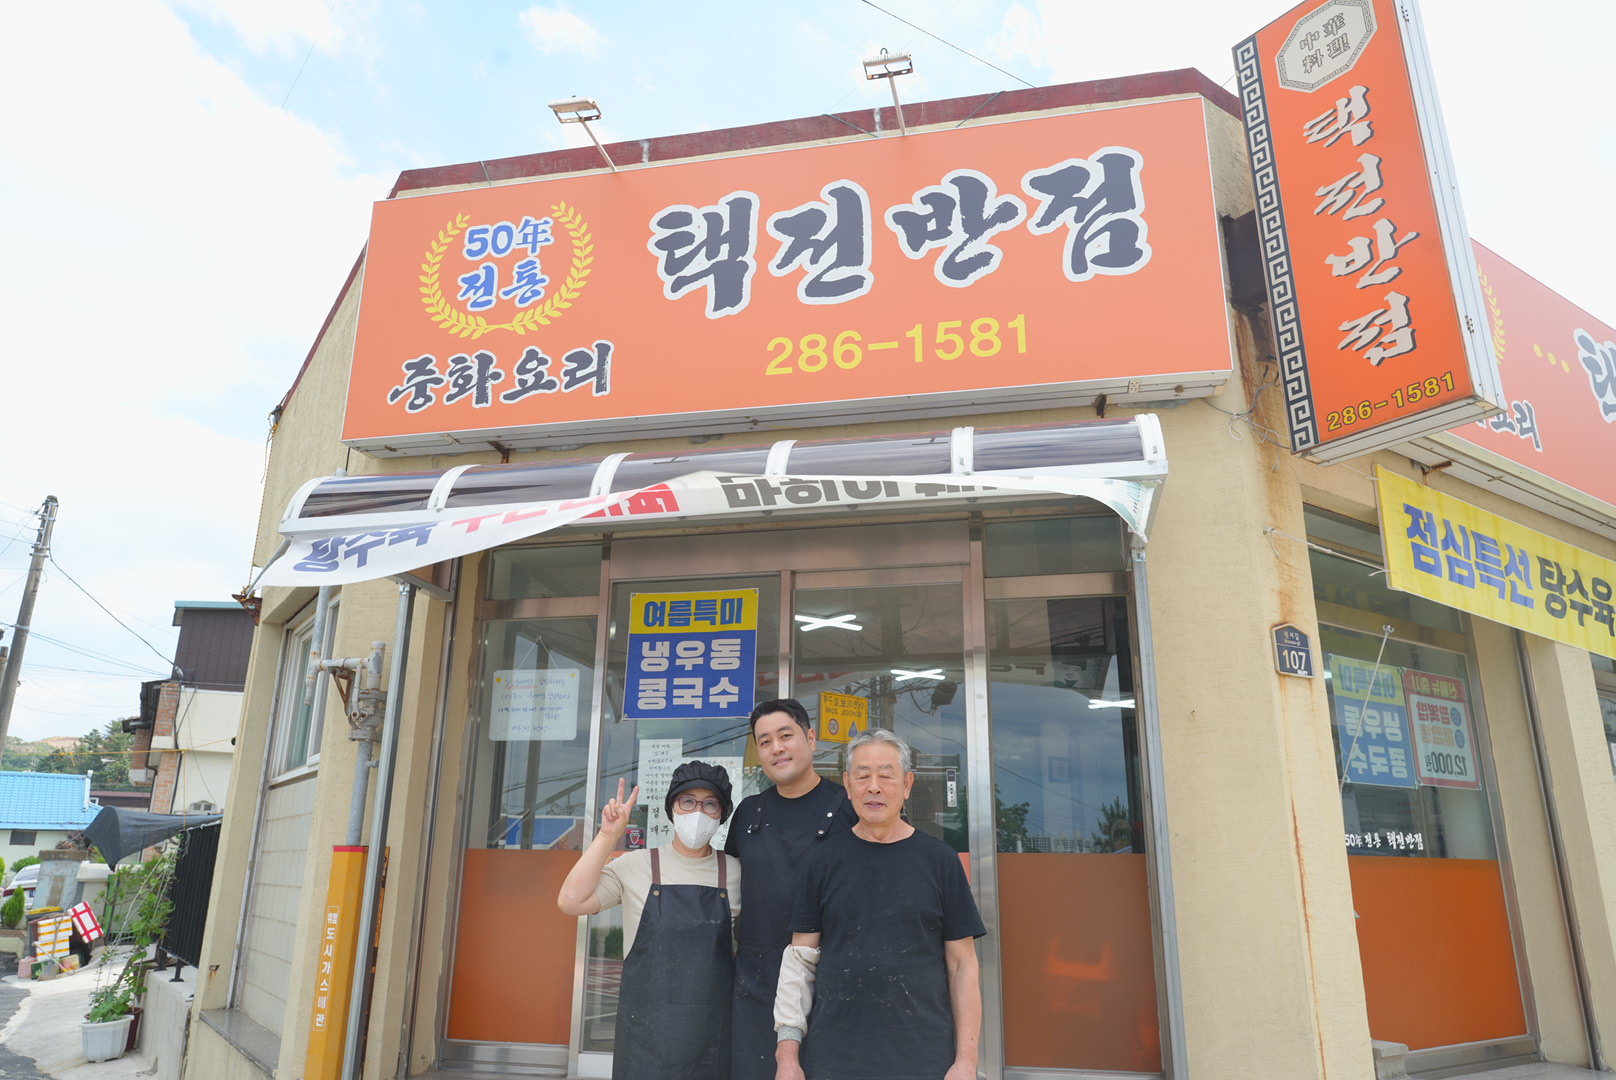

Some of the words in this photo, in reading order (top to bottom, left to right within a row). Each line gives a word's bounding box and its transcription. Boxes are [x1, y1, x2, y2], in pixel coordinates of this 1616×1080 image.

[1299, 13, 1346, 51] 中華
[1302, 33, 1351, 73] 料理
[464, 217, 554, 259] 50年
[650, 149, 1149, 316] 택전반점
[1302, 85, 1420, 367] 택전반점
[457, 258, 550, 310] 전통
[764, 314, 1028, 376] 286-1581
[1326, 372, 1456, 431] 286-1581
[1402, 502, 1534, 610] 점심특선
[1536, 555, 1616, 637] 탕수육
[643, 598, 743, 627] 여름특미
[640, 638, 742, 672] 냉우동
[1283, 649, 1306, 670] 107
[637, 677, 739, 710] 콩국수
[1364, 832, 1381, 848] 전통
[1386, 831, 1424, 851] 택전반점
